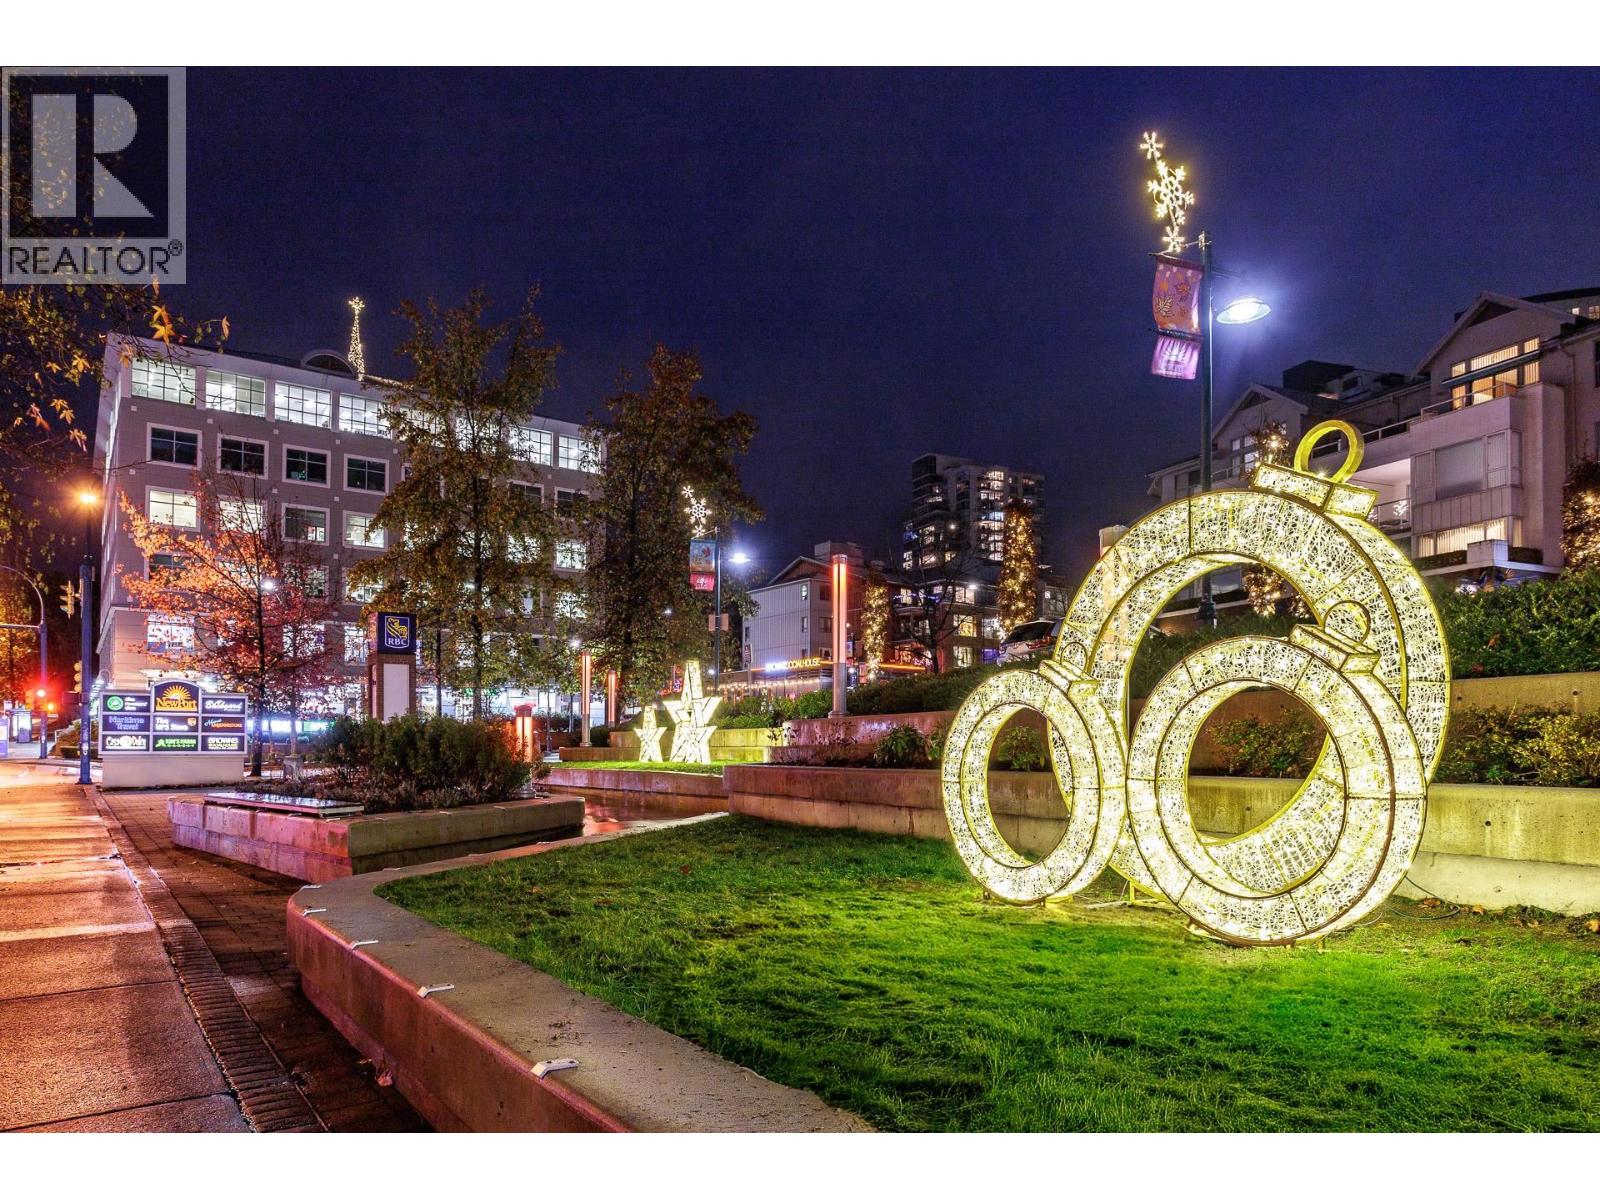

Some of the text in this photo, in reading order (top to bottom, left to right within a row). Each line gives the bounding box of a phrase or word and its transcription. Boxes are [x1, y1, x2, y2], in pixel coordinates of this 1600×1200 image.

[387, 637, 407, 646] RBC
[108, 715, 145, 724] Maritime
[155, 716, 169, 724] The
